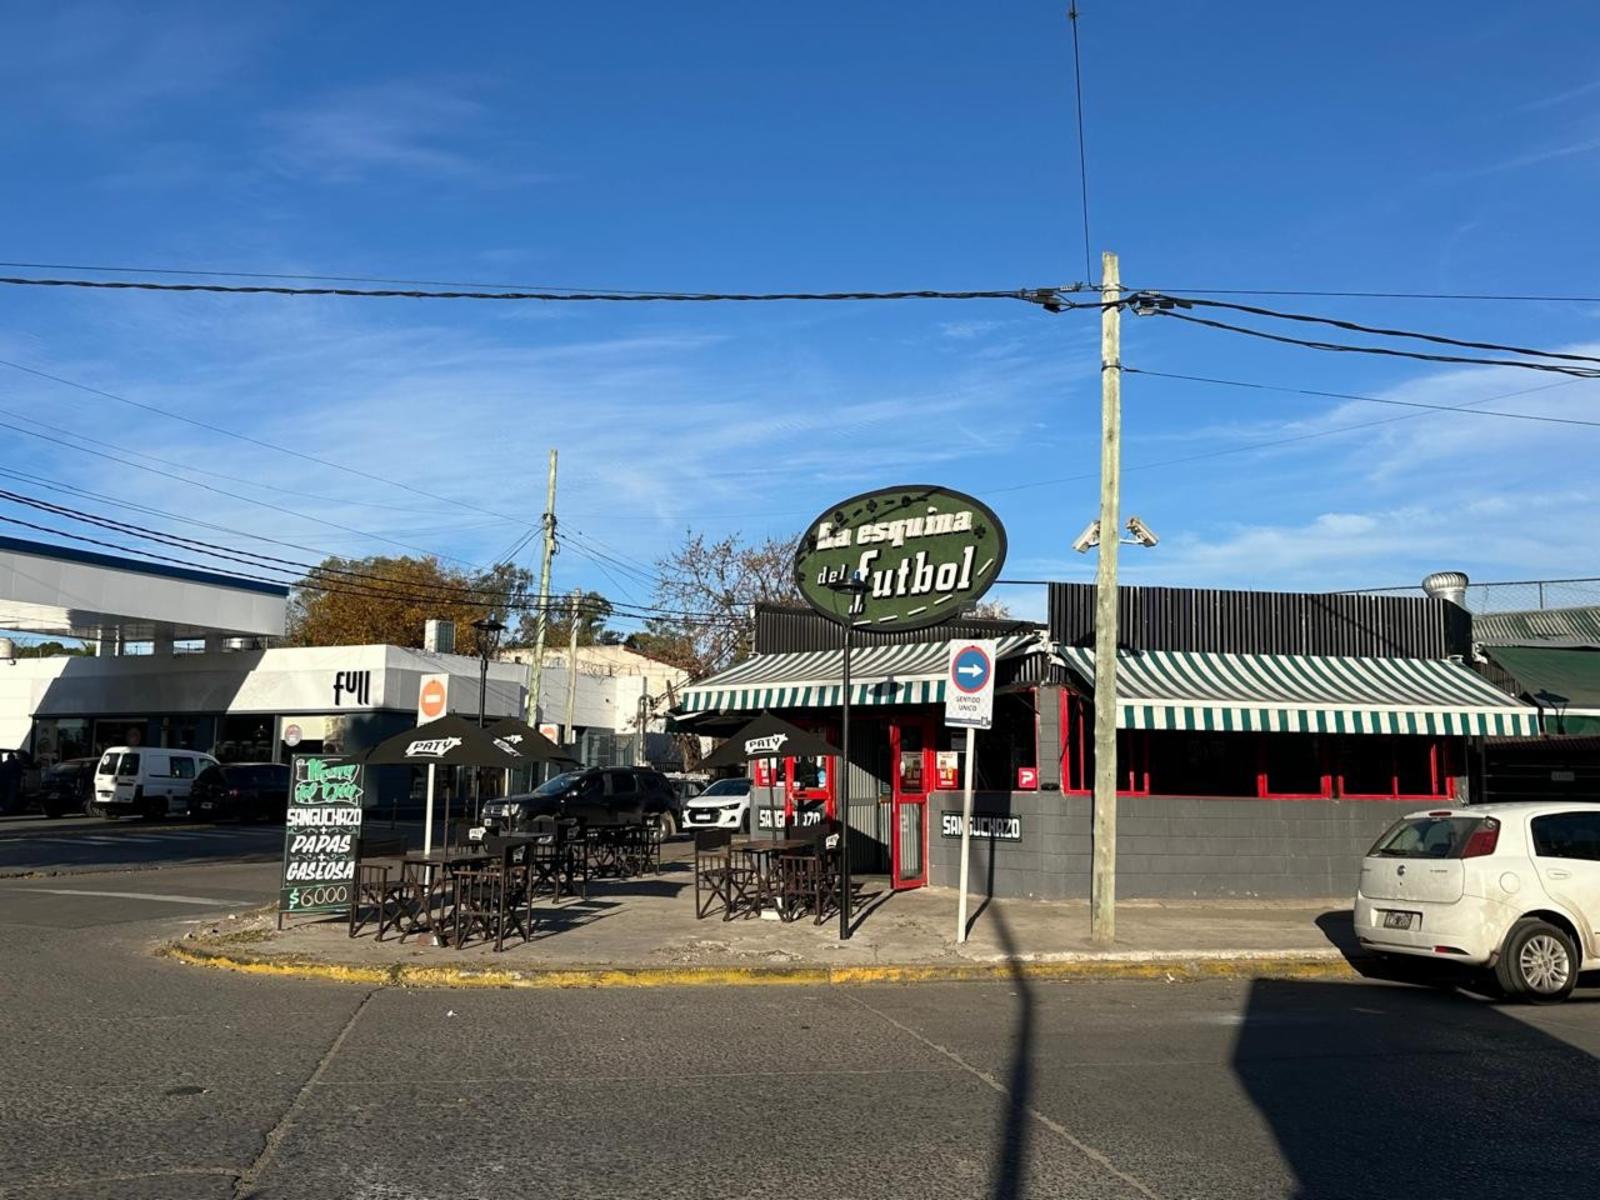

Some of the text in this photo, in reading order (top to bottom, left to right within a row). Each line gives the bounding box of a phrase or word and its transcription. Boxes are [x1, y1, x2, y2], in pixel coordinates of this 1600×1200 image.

[816, 506, 974, 550] La esquina
[817, 546, 974, 614] del futbol
[333, 670, 371, 706] full
[413, 740, 453, 751] PATY
[749, 737, 780, 748] PATY
[286, 808, 362, 826] SANGUCHAZO
[291, 834, 352, 853] PAPAS
[286, 861, 356, 881] GASEOSA
